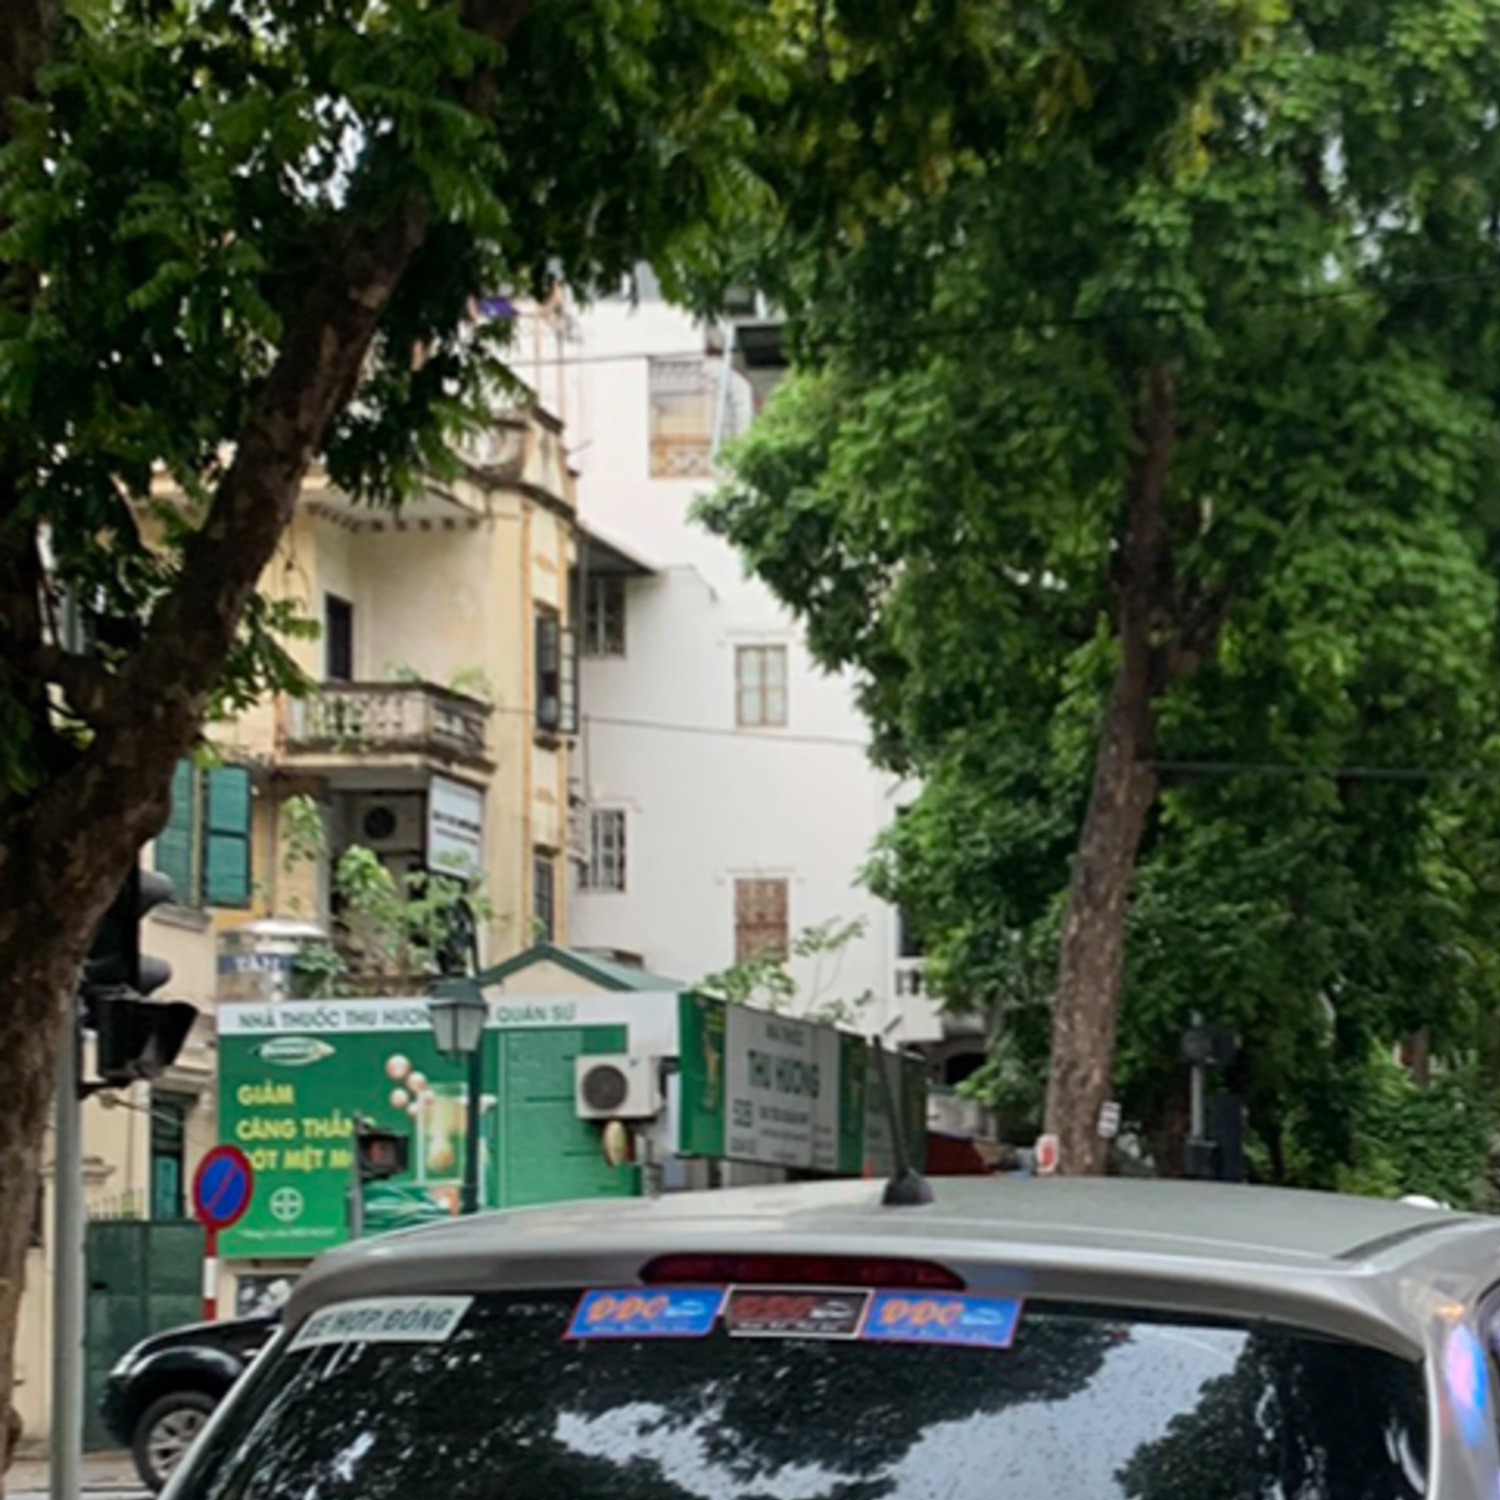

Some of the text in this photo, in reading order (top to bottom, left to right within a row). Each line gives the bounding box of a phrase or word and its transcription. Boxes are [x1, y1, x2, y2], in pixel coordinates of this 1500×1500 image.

[281, 1004, 341, 1027] THUỐC
[345, 1009, 378, 1026] THU
[382, 1007, 433, 1026] HƯƠN
[236, 1078, 295, 1106] GIẢM
